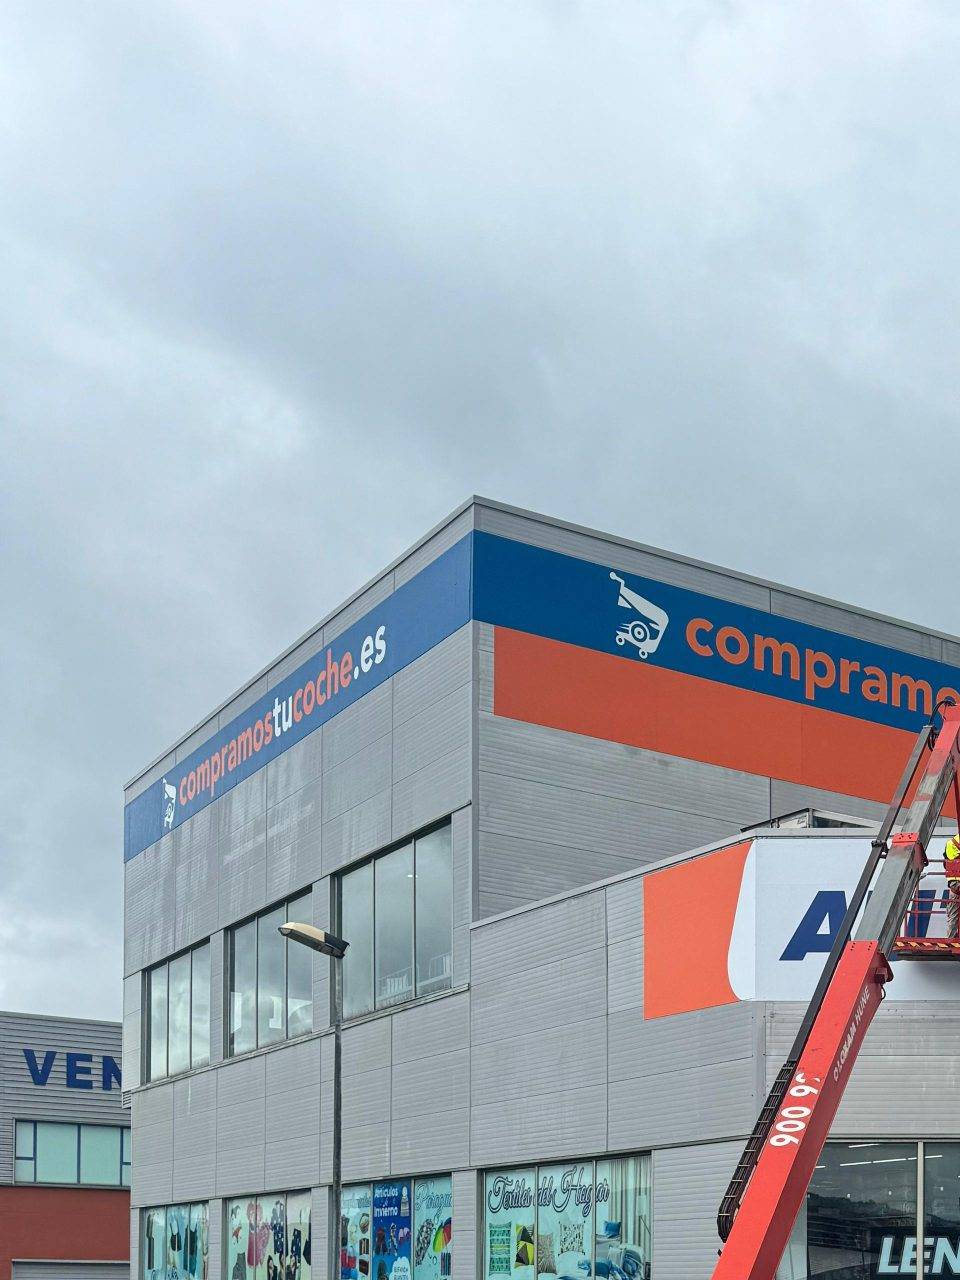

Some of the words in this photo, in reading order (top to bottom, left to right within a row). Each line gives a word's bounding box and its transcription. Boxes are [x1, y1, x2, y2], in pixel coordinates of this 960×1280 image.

[178, 624, 387, 806] compramostucoche.es
[769, 1106, 812, 1147] 900
[552, 1165, 610, 1218] Hogar
